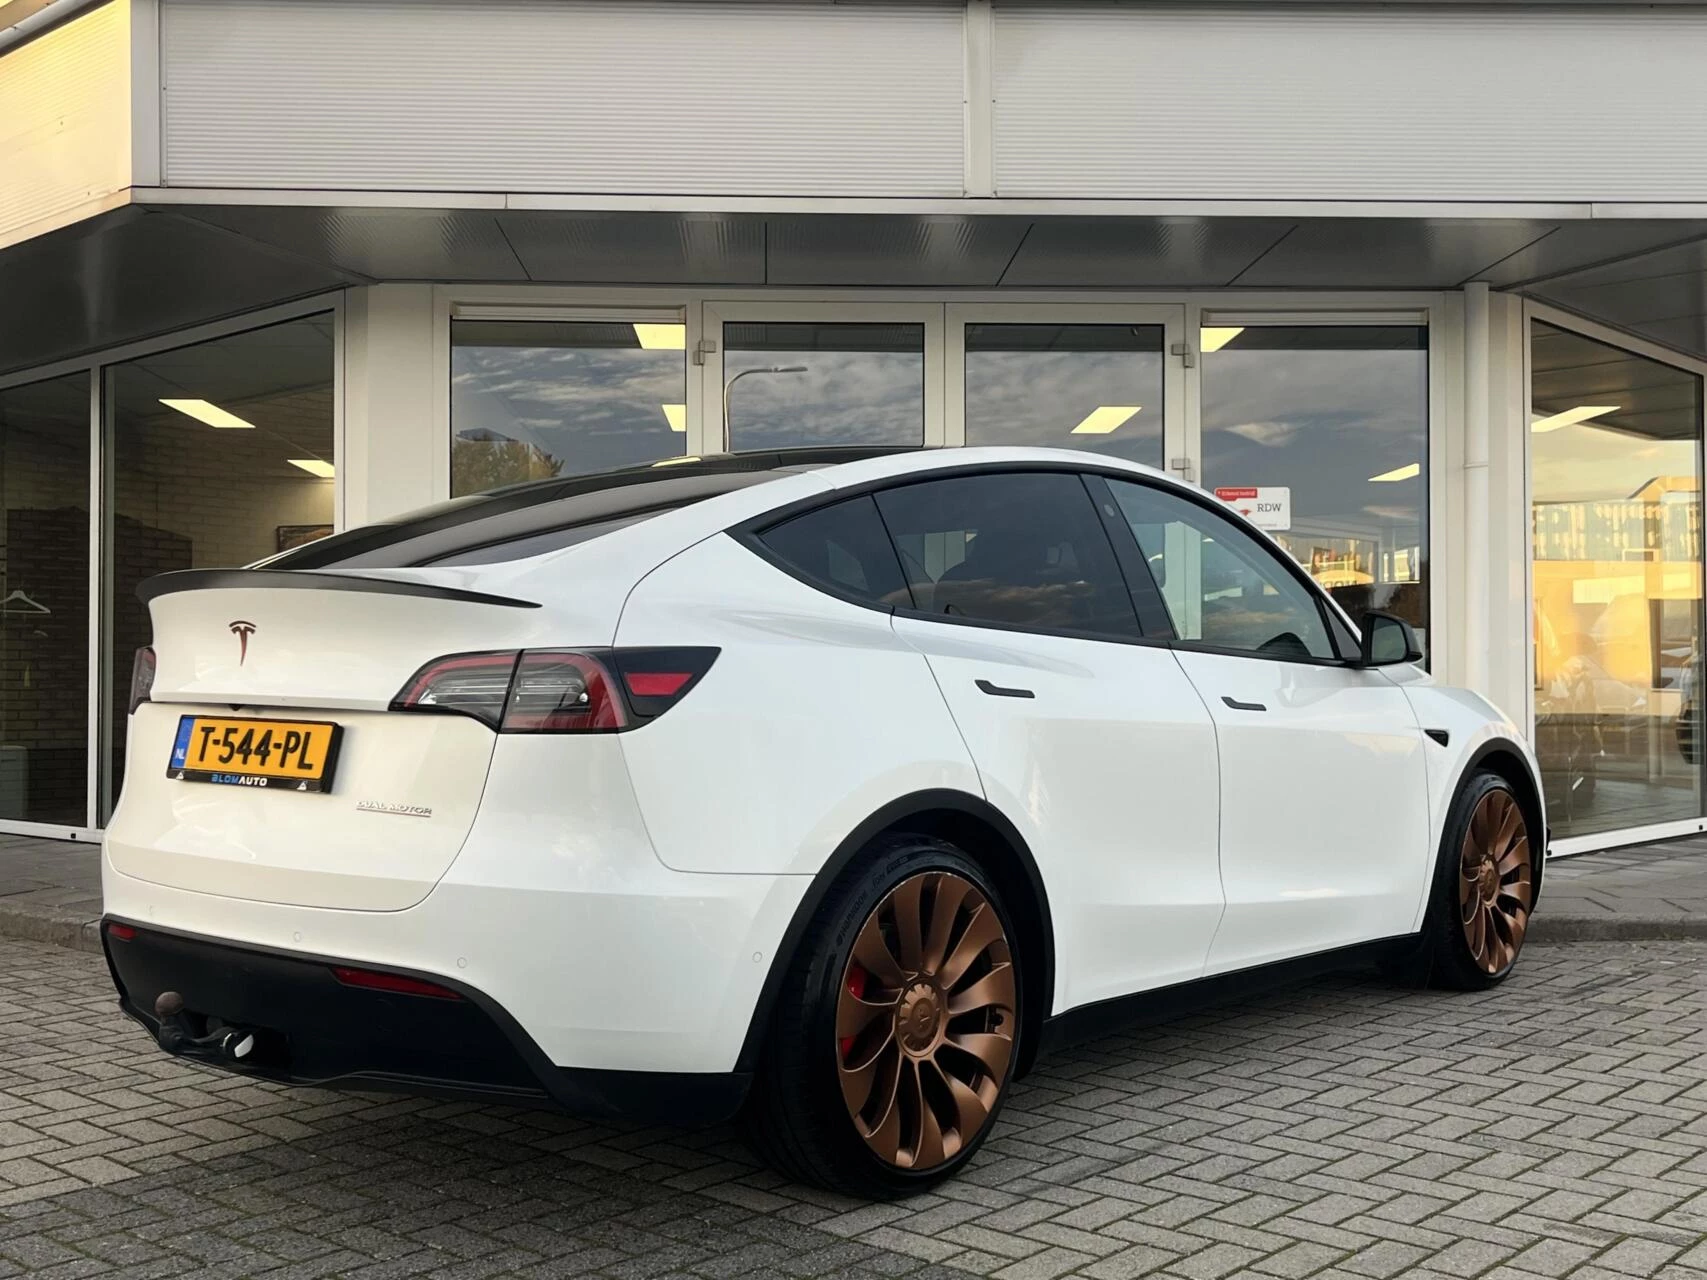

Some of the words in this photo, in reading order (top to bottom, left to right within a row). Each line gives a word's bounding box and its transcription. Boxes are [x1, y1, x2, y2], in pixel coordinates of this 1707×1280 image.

[1256, 503, 1281, 512] RDW
[175, 748, 185, 760] NL
[198, 727, 313, 770] T-544-PL
[356, 800, 387, 811] DUAL
[388, 803, 433, 815] MOTOR
